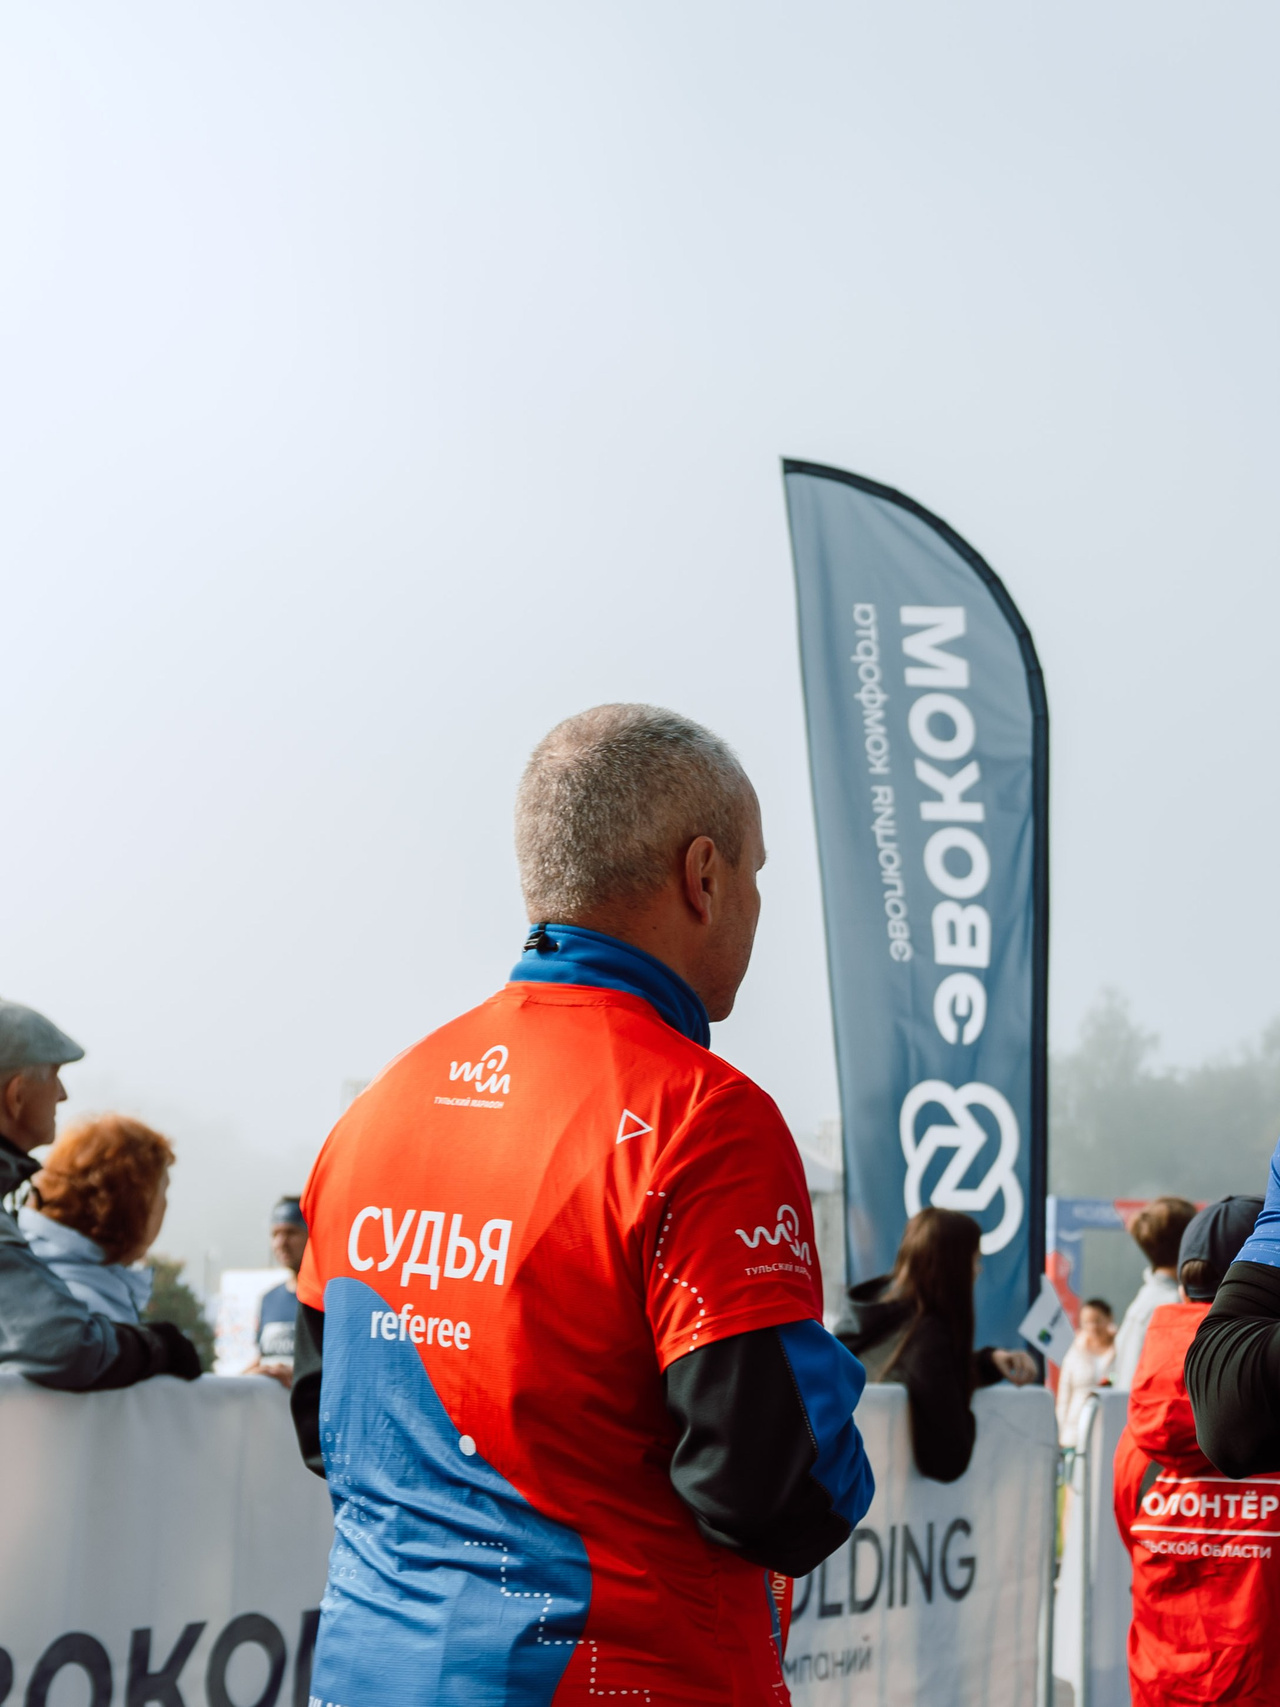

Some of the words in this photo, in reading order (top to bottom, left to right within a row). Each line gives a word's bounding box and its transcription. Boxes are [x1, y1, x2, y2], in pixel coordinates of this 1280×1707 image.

[348, 1206, 513, 1290] СУДЬЯ
[370, 1303, 471, 1350] referee
[1142, 1490, 1280, 1520] ОЛОНТЁР
[1137, 1540, 1198, 1557] ЬСКОЙ
[1201, 1543, 1272, 1559] ОБЛАСТИ
[0, 1610, 320, 1707] ОКО
